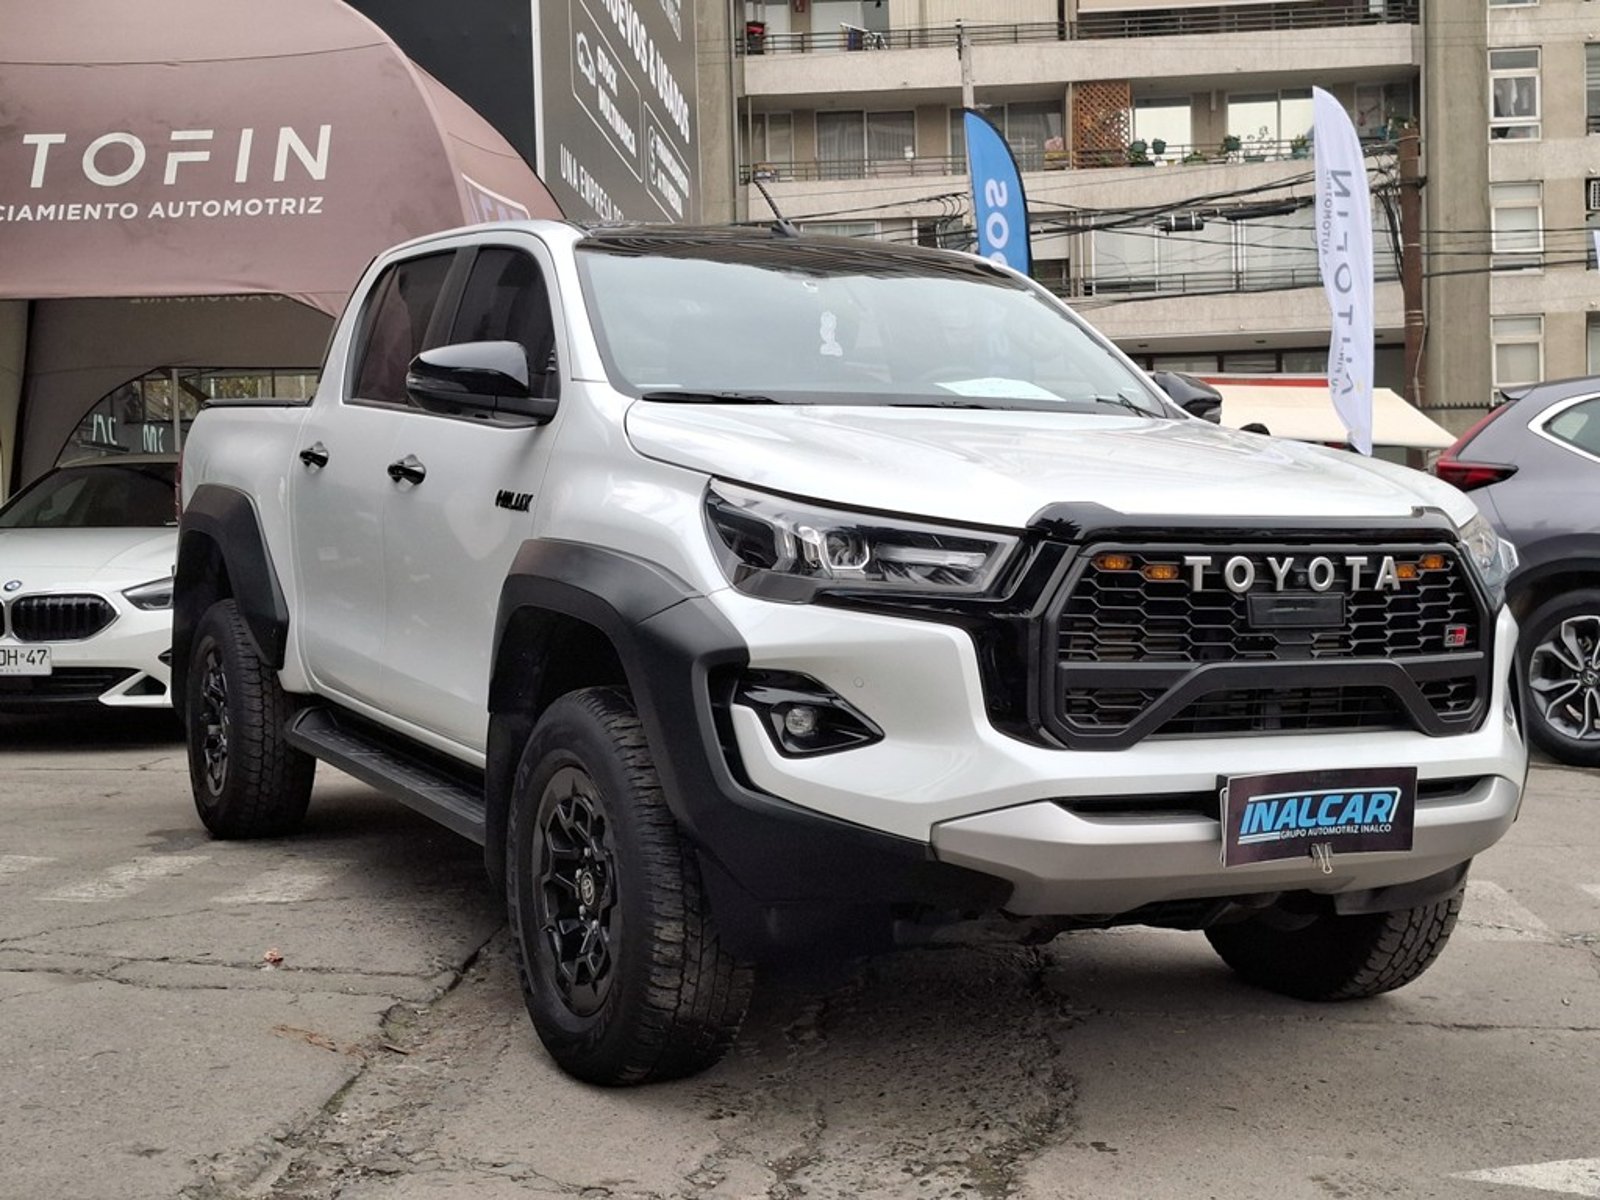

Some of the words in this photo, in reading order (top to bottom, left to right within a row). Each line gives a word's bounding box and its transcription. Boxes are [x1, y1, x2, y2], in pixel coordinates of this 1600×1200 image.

[602, 0, 648, 73] UEVOS
[560, 143, 579, 192] UNA
[148, 196, 324, 219] AUTOMOTRIZ
[1184, 555, 1402, 593] TOYOTA
[1240, 793, 1393, 834] INALCAR
[1280, 827, 1306, 839] GRUPO
[1307, 825, 1359, 836] AUTOMOTRIZ
[1360, 824, 1392, 834] INALCO
